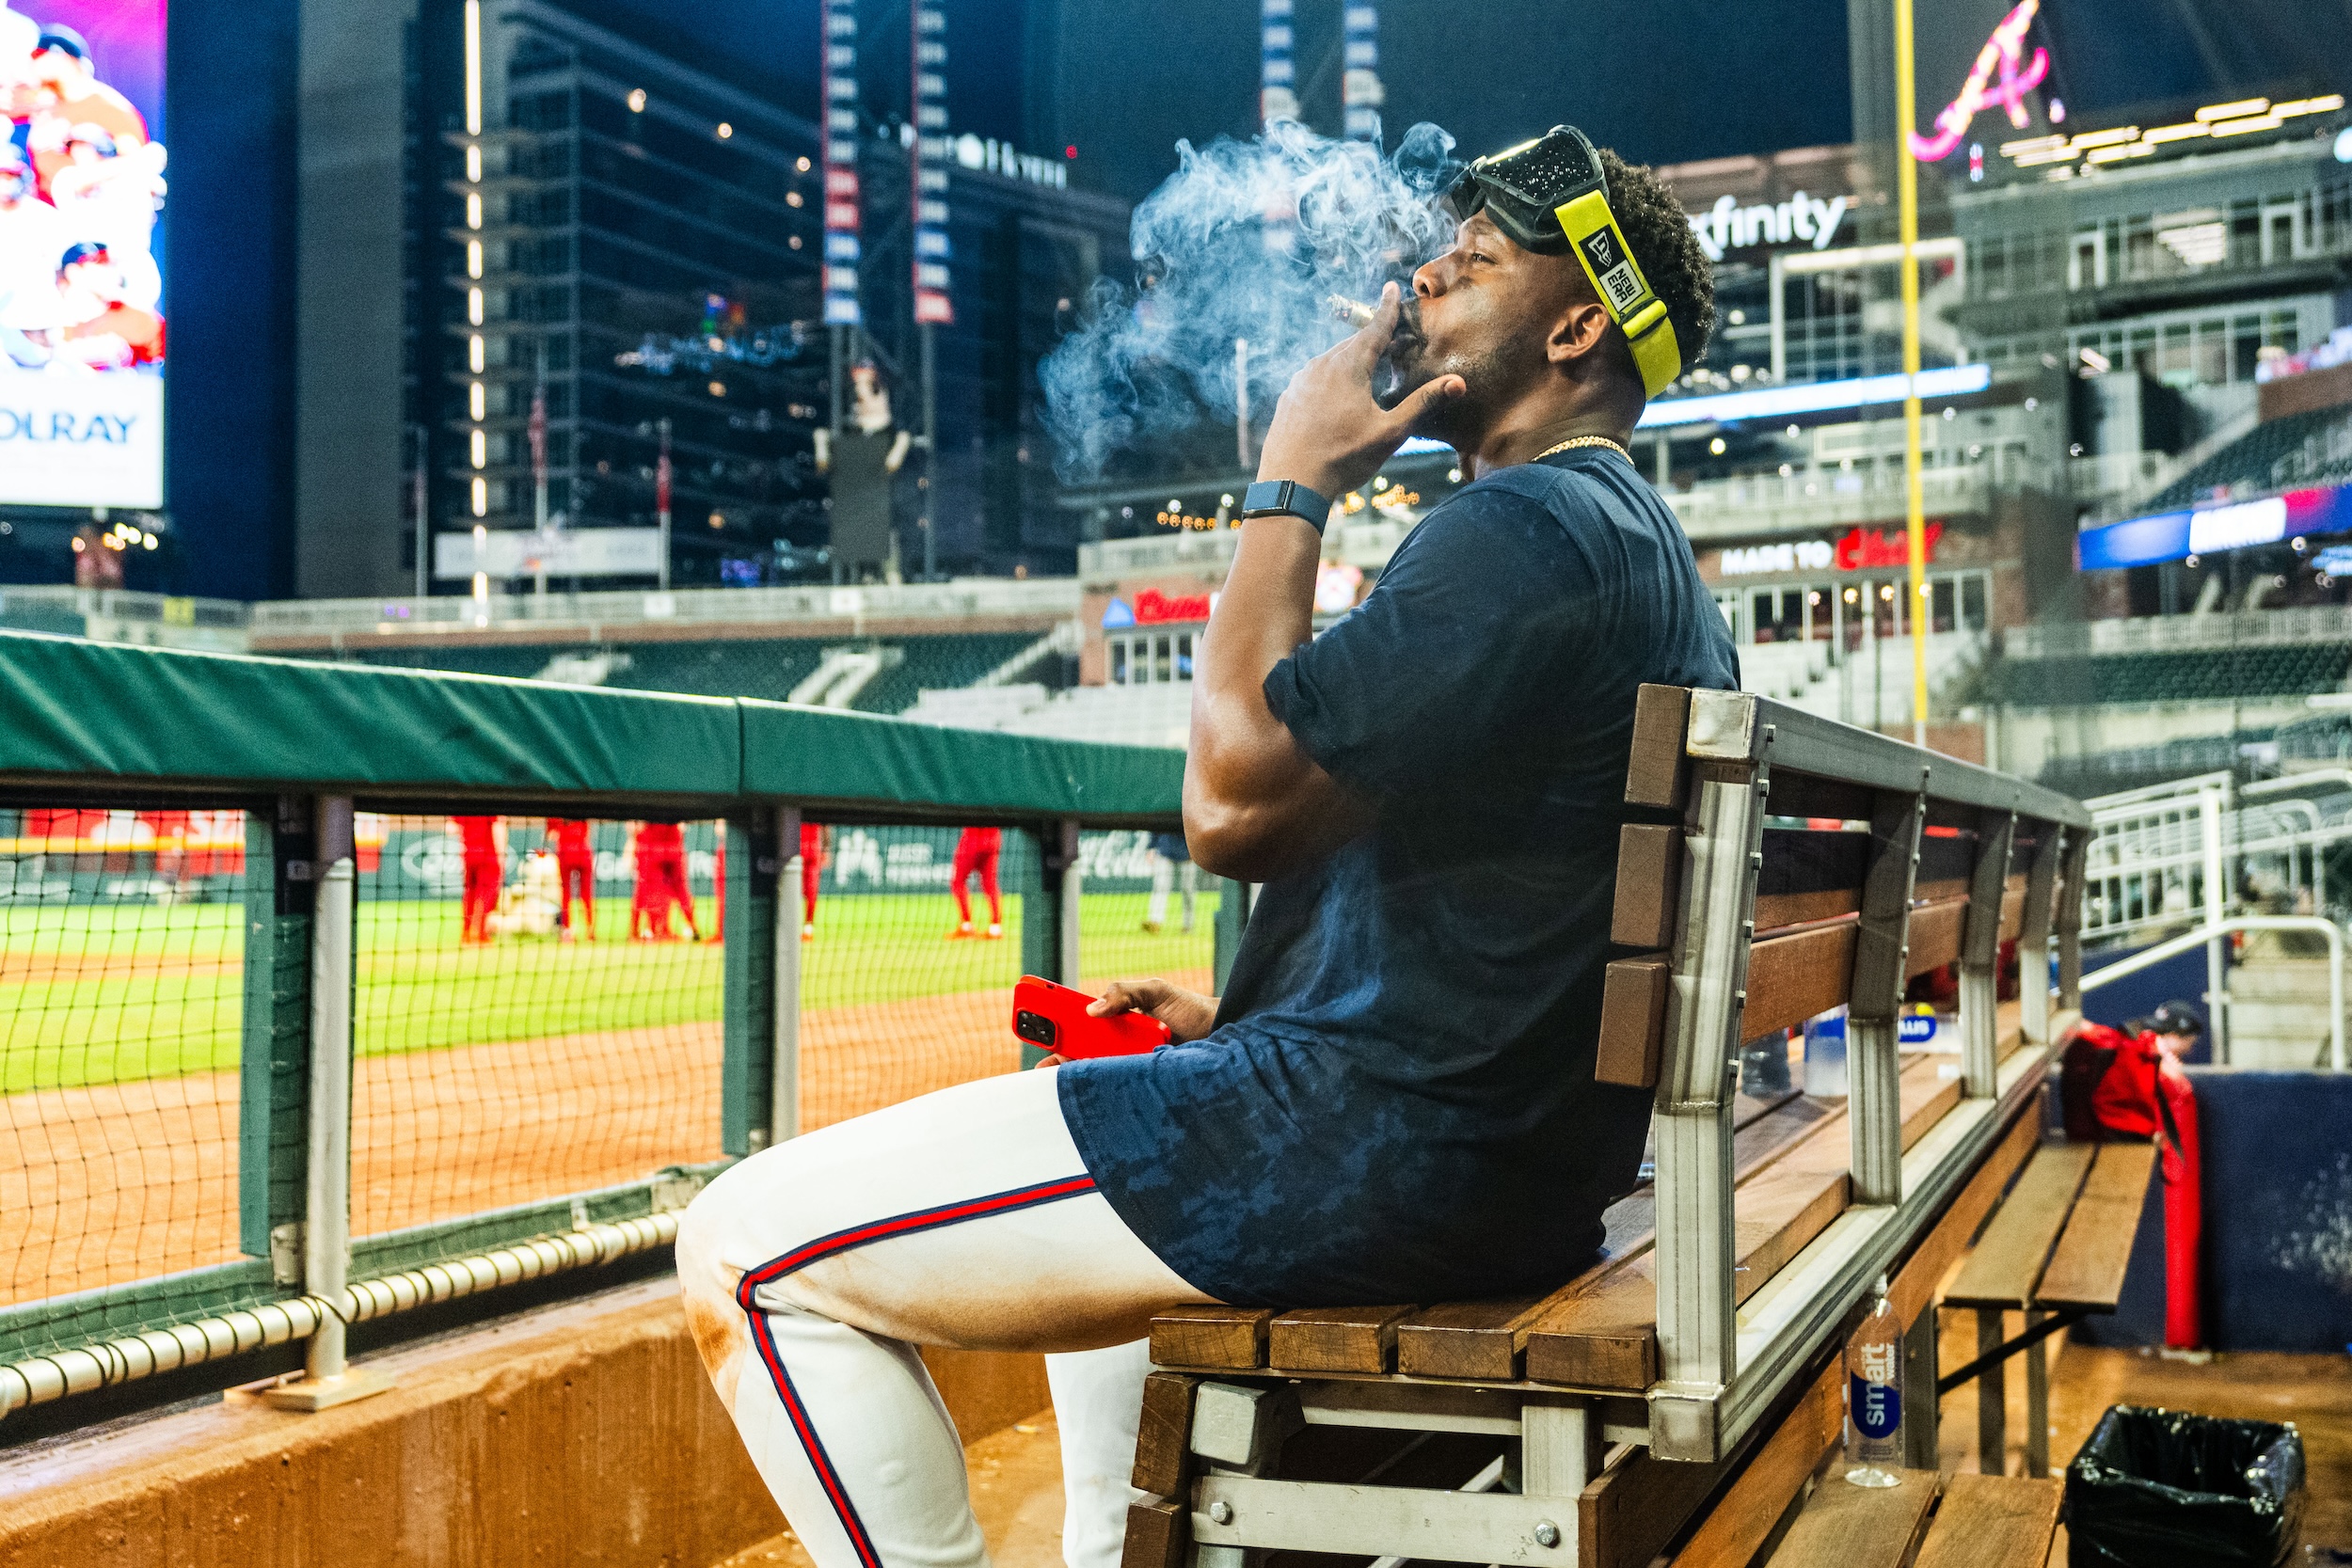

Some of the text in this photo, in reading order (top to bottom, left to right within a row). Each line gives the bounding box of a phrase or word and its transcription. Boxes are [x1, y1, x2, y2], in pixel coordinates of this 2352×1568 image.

[1607, 274, 1629, 303] ERA
[1615, 267, 1637, 297] NEW
[1885, 1342, 1896, 1381] water
[1861, 1342, 1885, 1426] smart
